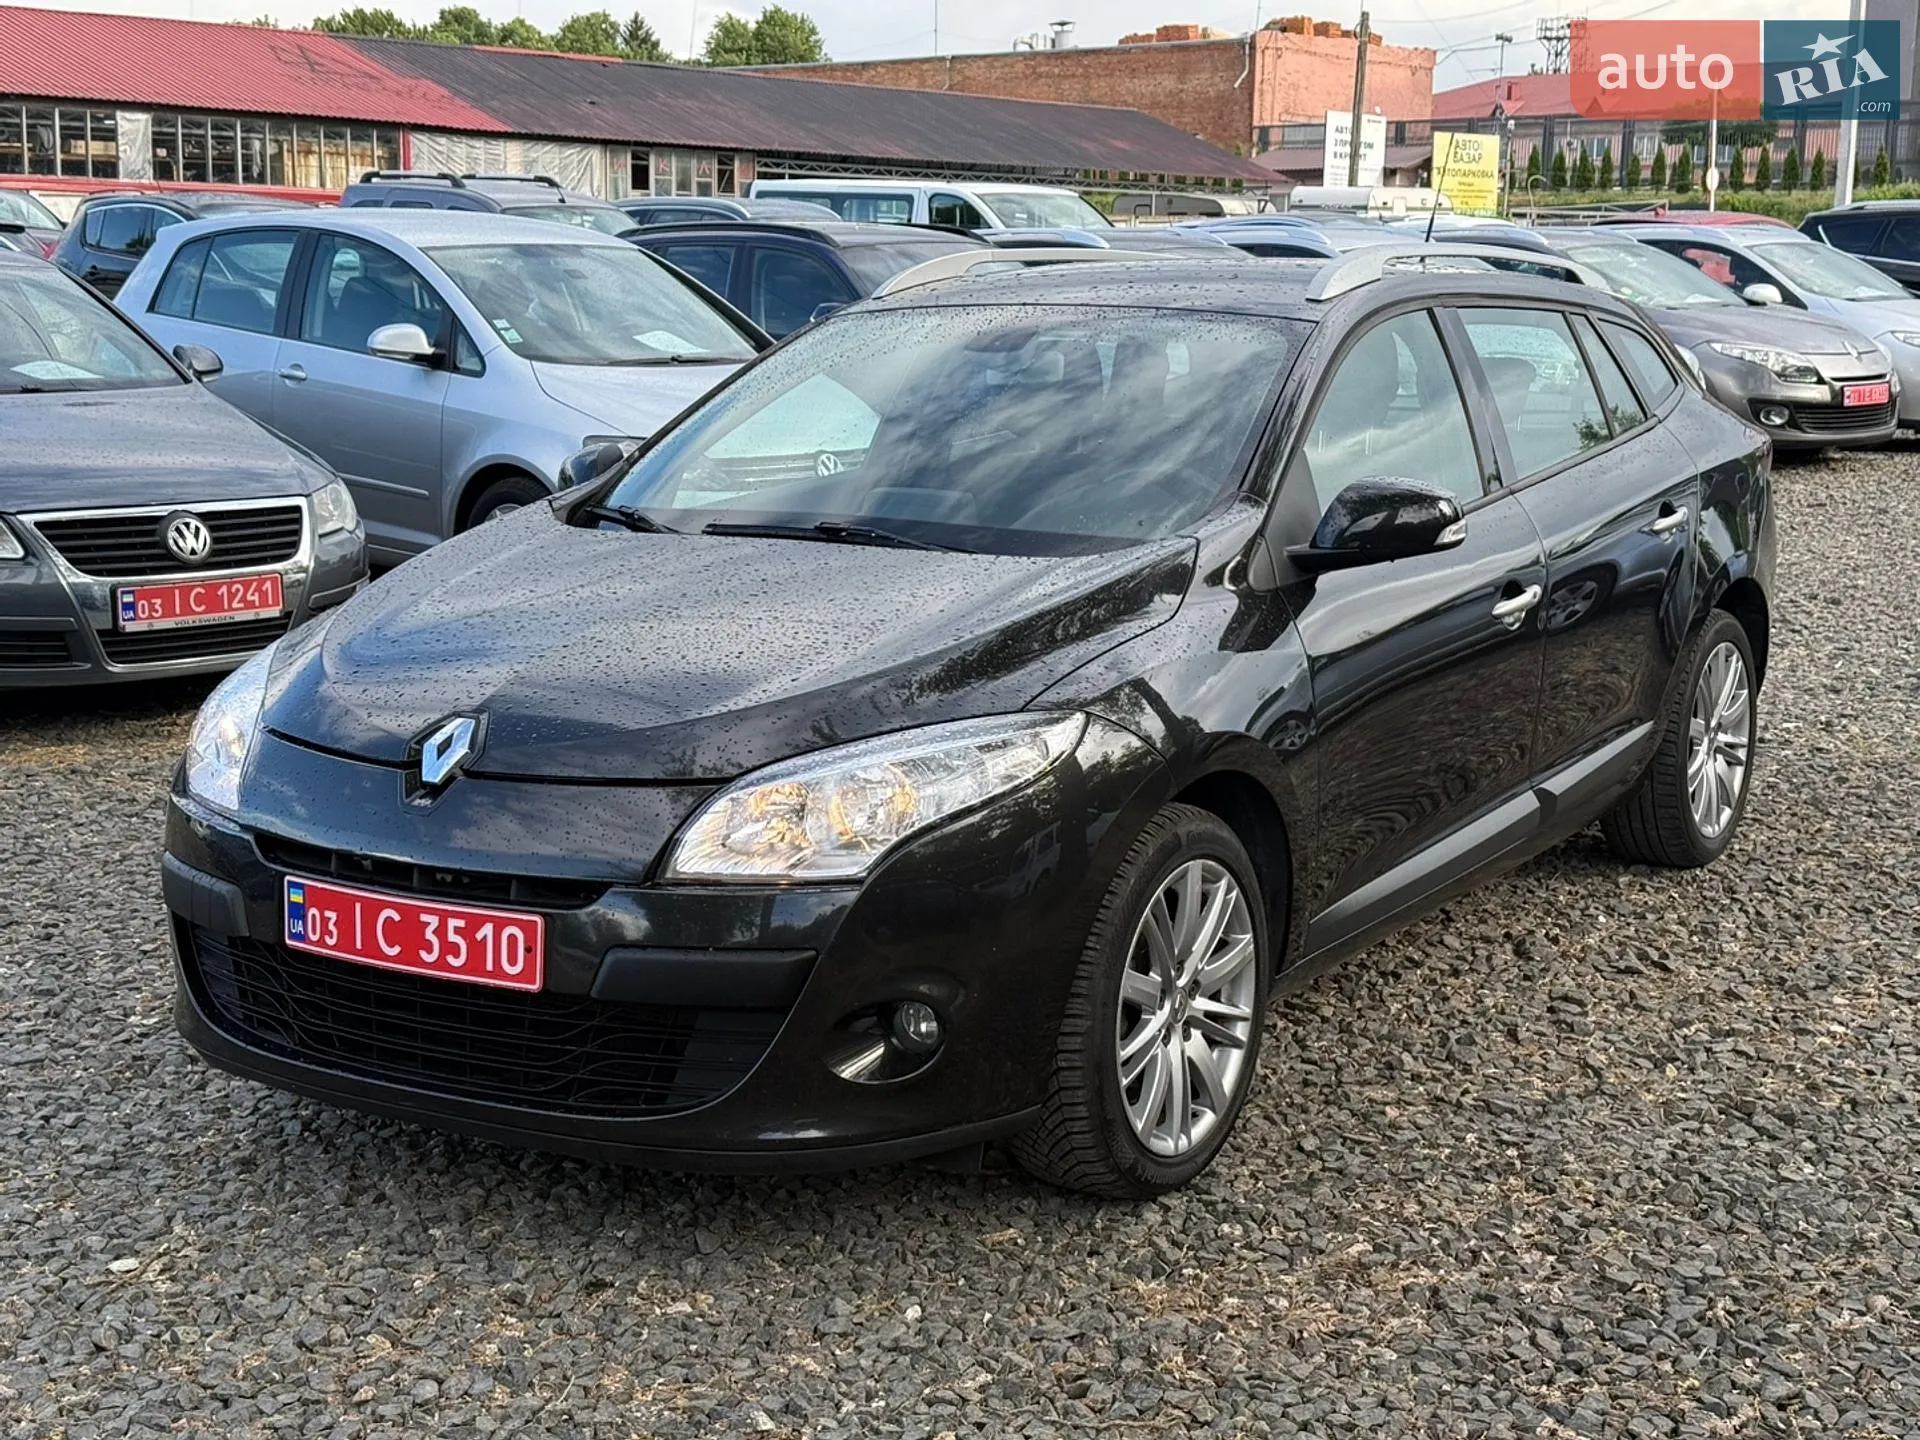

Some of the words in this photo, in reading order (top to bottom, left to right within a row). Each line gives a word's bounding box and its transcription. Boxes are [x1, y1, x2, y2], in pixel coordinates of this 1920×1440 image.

[1454, 139, 1480, 152] АВТО
[1452, 151, 1483, 165] БАЗАР
[137, 598, 163, 619] 03
[216, 579, 274, 611] 1241
[122, 609, 135, 620] UA
[174, 615, 236, 627] VOLKSWAGEN
[290, 918, 304, 935] UA
[307, 907, 338, 947] 03
[418, 912, 525, 976] 3510
